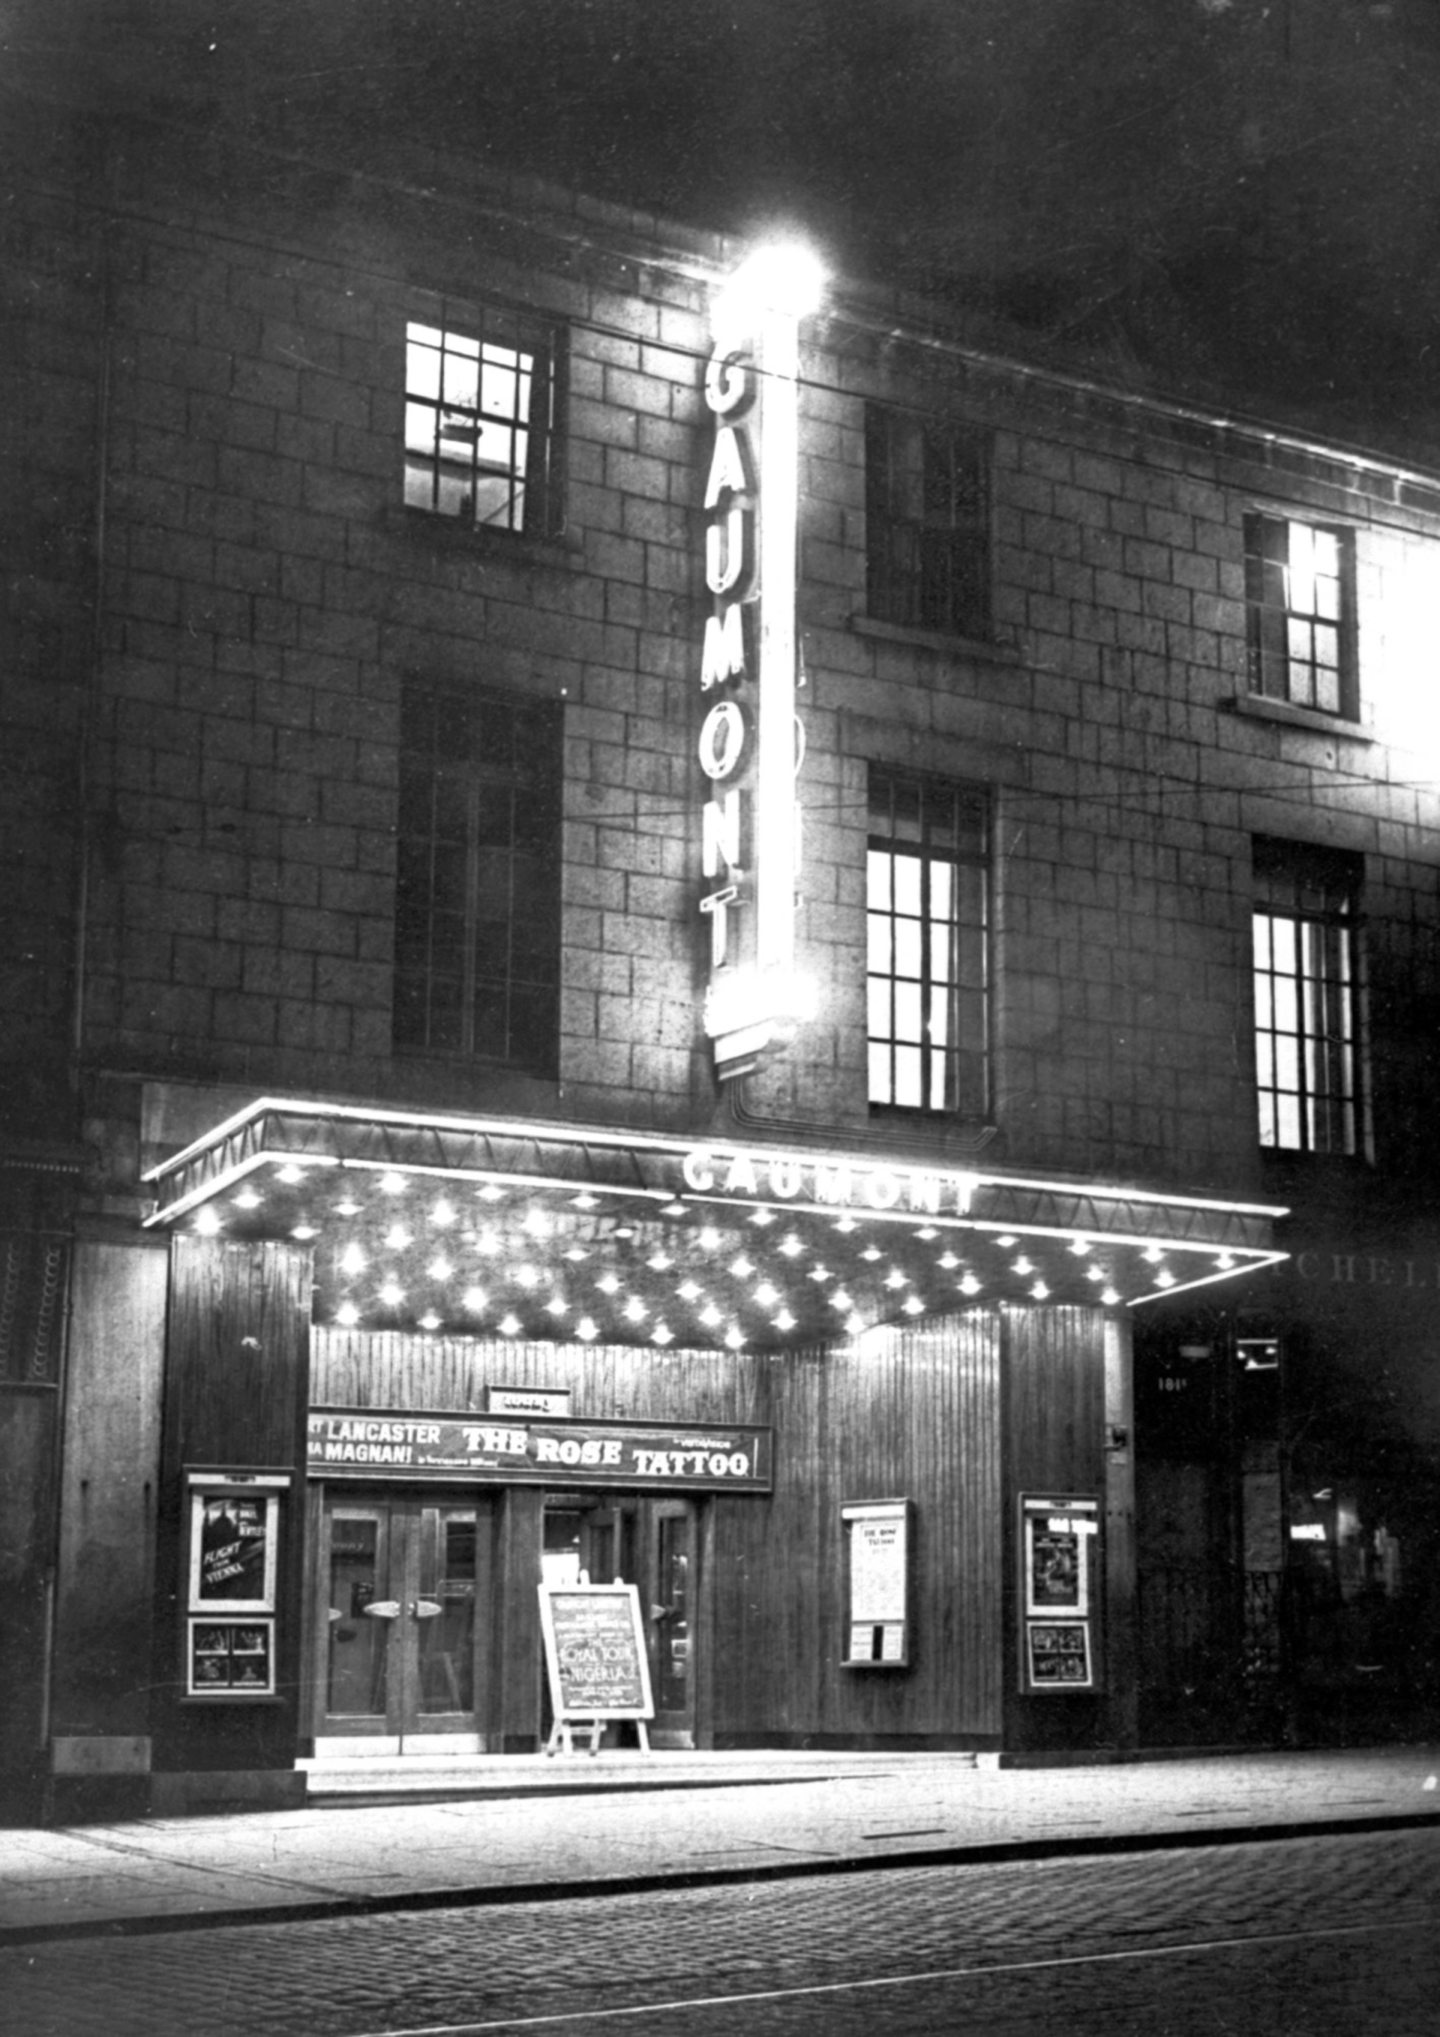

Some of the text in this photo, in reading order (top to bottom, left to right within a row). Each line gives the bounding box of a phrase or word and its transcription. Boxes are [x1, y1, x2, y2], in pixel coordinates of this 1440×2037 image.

[697, 342, 749, 968] GAUMONT
[682, 1150, 980, 1216] GAUMONT
[327, 1420, 441, 1445] LANCASTER
[325, 1442, 413, 1464] MAGNANI
[462, 1427, 749, 1476] THE ROSE TATTOO
[203, 1540, 242, 1565] FLIGHT
[205, 1563, 244, 1583] VIENNA
[569, 1665, 627, 1682] NIGERIA
